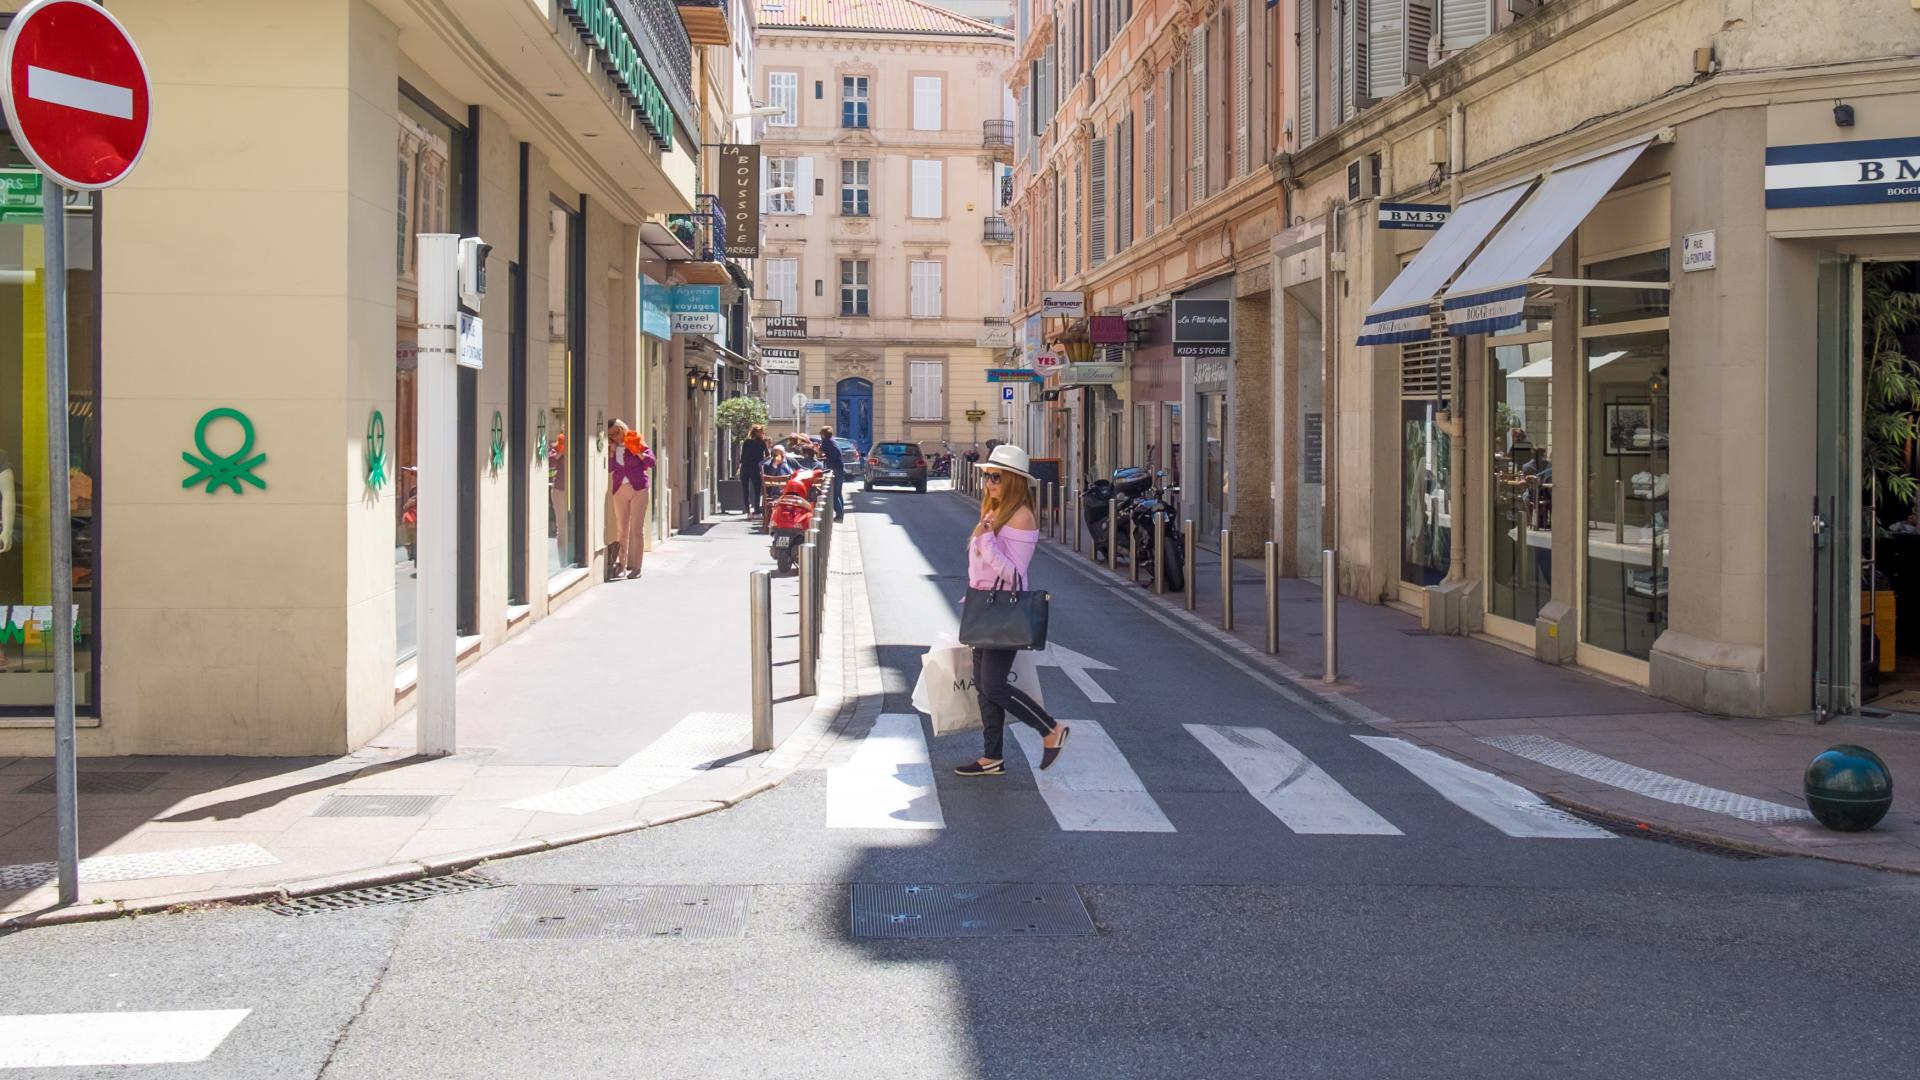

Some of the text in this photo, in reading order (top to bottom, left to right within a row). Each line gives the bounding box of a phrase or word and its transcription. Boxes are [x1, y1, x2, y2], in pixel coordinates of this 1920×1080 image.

[722, 146, 740, 155] LA
[736, 155, 750, 243] BOUSSOLE
[1693, 239, 1703, 249] RUE
[724, 245, 757, 255] ARREE
[674, 303, 715, 312] voyages
[678, 313, 709, 322] Travel
[674, 322, 714, 332] Agency
[773, 329, 806, 338] FESTIVAL
[1177, 346, 1228, 355] KIDS STORE
[1037, 357, 1057, 366] YES
